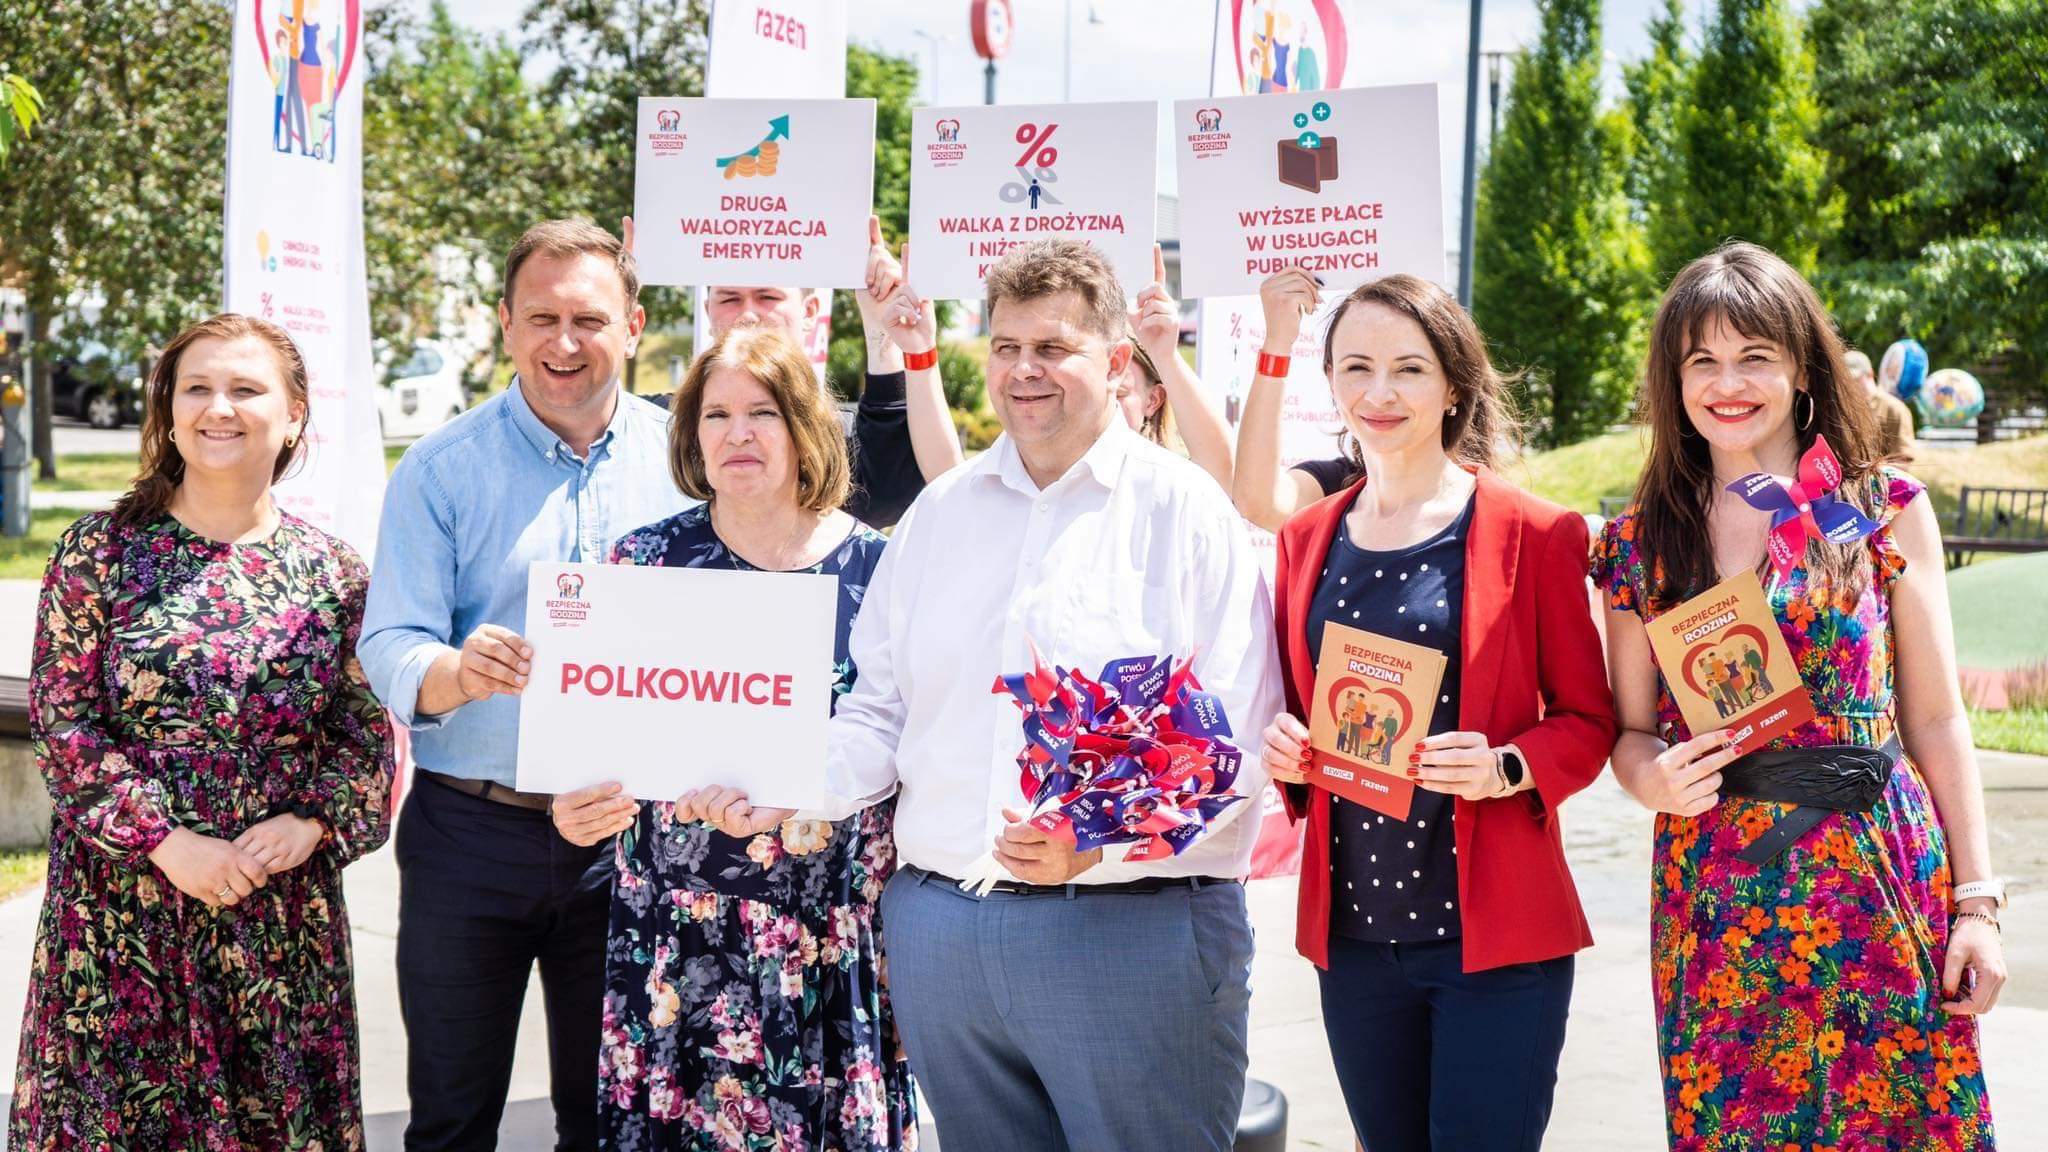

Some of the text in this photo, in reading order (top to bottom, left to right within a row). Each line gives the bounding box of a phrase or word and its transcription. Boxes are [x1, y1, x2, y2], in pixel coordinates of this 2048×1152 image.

[927, 143, 968, 151] BEZPIECZNA
[1187, 132, 1232, 142] BEZPIECZNA
[721, 196, 787, 212] DRUGA
[939, 212, 1125, 234] WALKA Z DROŻYZNĄ
[1239, 203, 1383, 227] WYŻSZE PŁACE
[681, 218, 827, 237] WALORYZACJA
[969, 242, 974, 257] I
[1246, 229, 1377, 251] W USŁUGACH
[702, 242, 802, 260] EMERYTUR
[1746, 478, 1774, 498] OBERT
[546, 600, 592, 610] BEZPIECZNA
[550, 610, 586, 620] RODZINA
[1671, 595, 1740, 635] BEZPIECZNA
[1684, 610, 1738, 644] RODZINA
[1118, 662, 1146, 674] #TWÓJ
[1344, 644, 1413, 672] BEZPIECZNA
[1138, 669, 1165, 692] #TWÓJ
[1348, 660, 1403, 685] RODZINA
[561, 663, 792, 706] POLKOWICE
[1193, 698, 1210, 730] #TWÓJ
[1760, 709, 1788, 729] razem
[1361, 779, 1389, 794] razem
